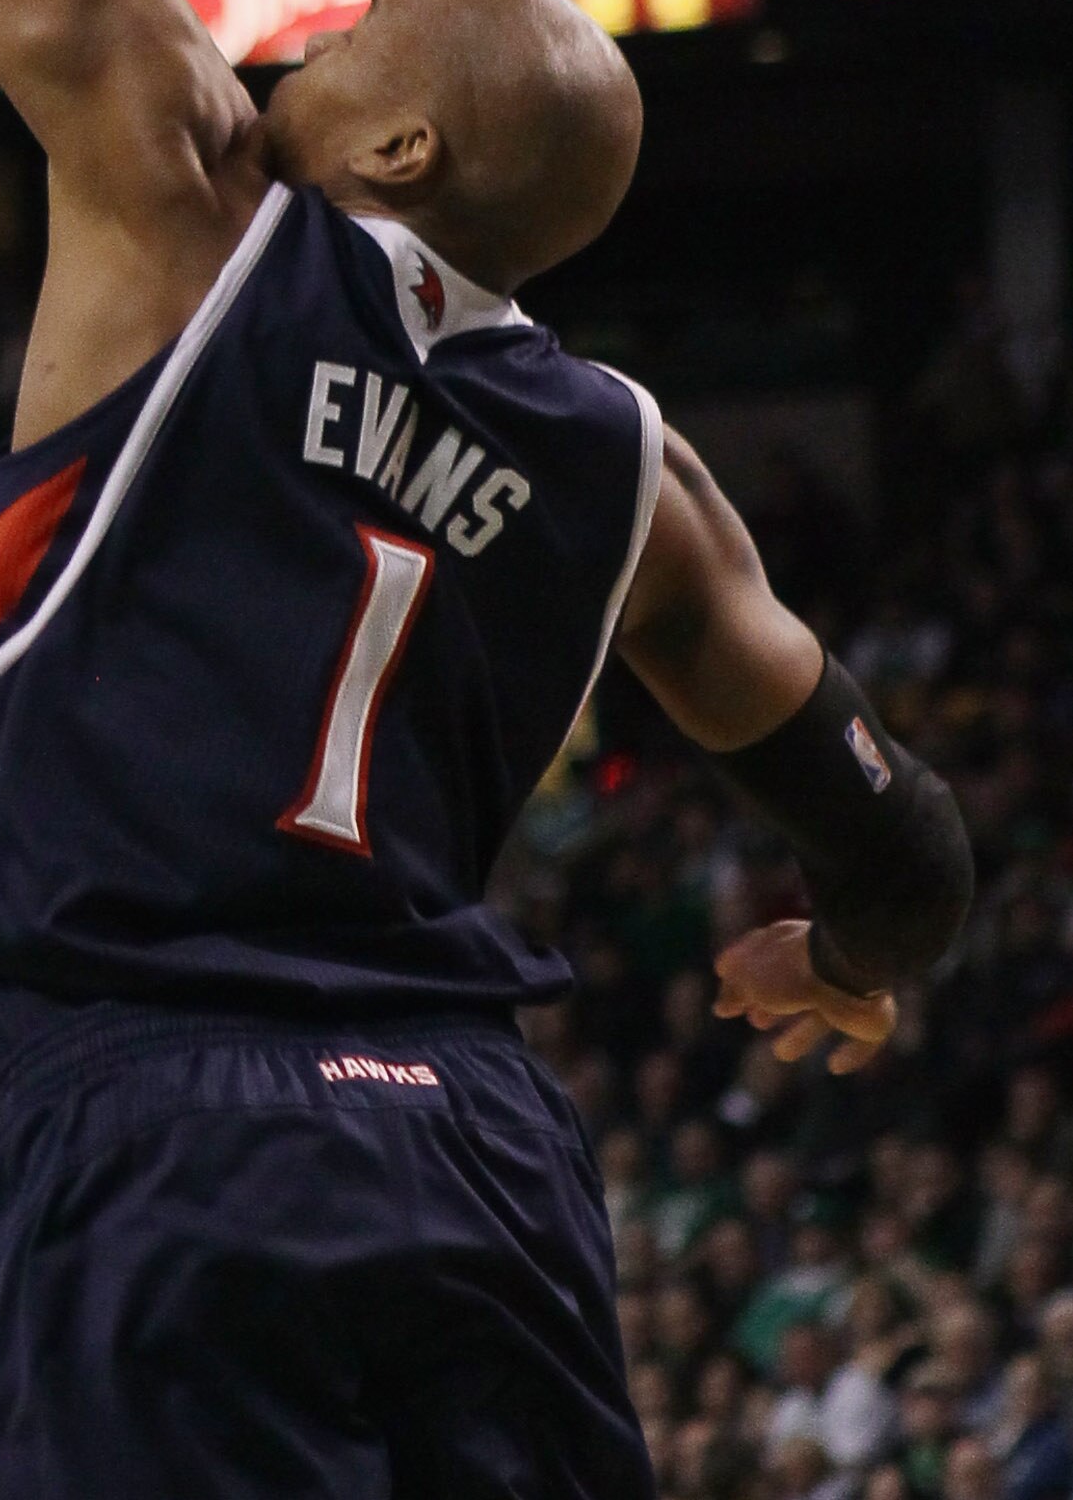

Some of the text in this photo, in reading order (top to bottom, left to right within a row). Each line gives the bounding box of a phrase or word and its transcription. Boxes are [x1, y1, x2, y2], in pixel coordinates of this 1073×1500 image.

[303, 360, 531, 558] EVANS
[276, 521, 435, 859] 1
[317, 1053, 440, 1086] HAWKS
